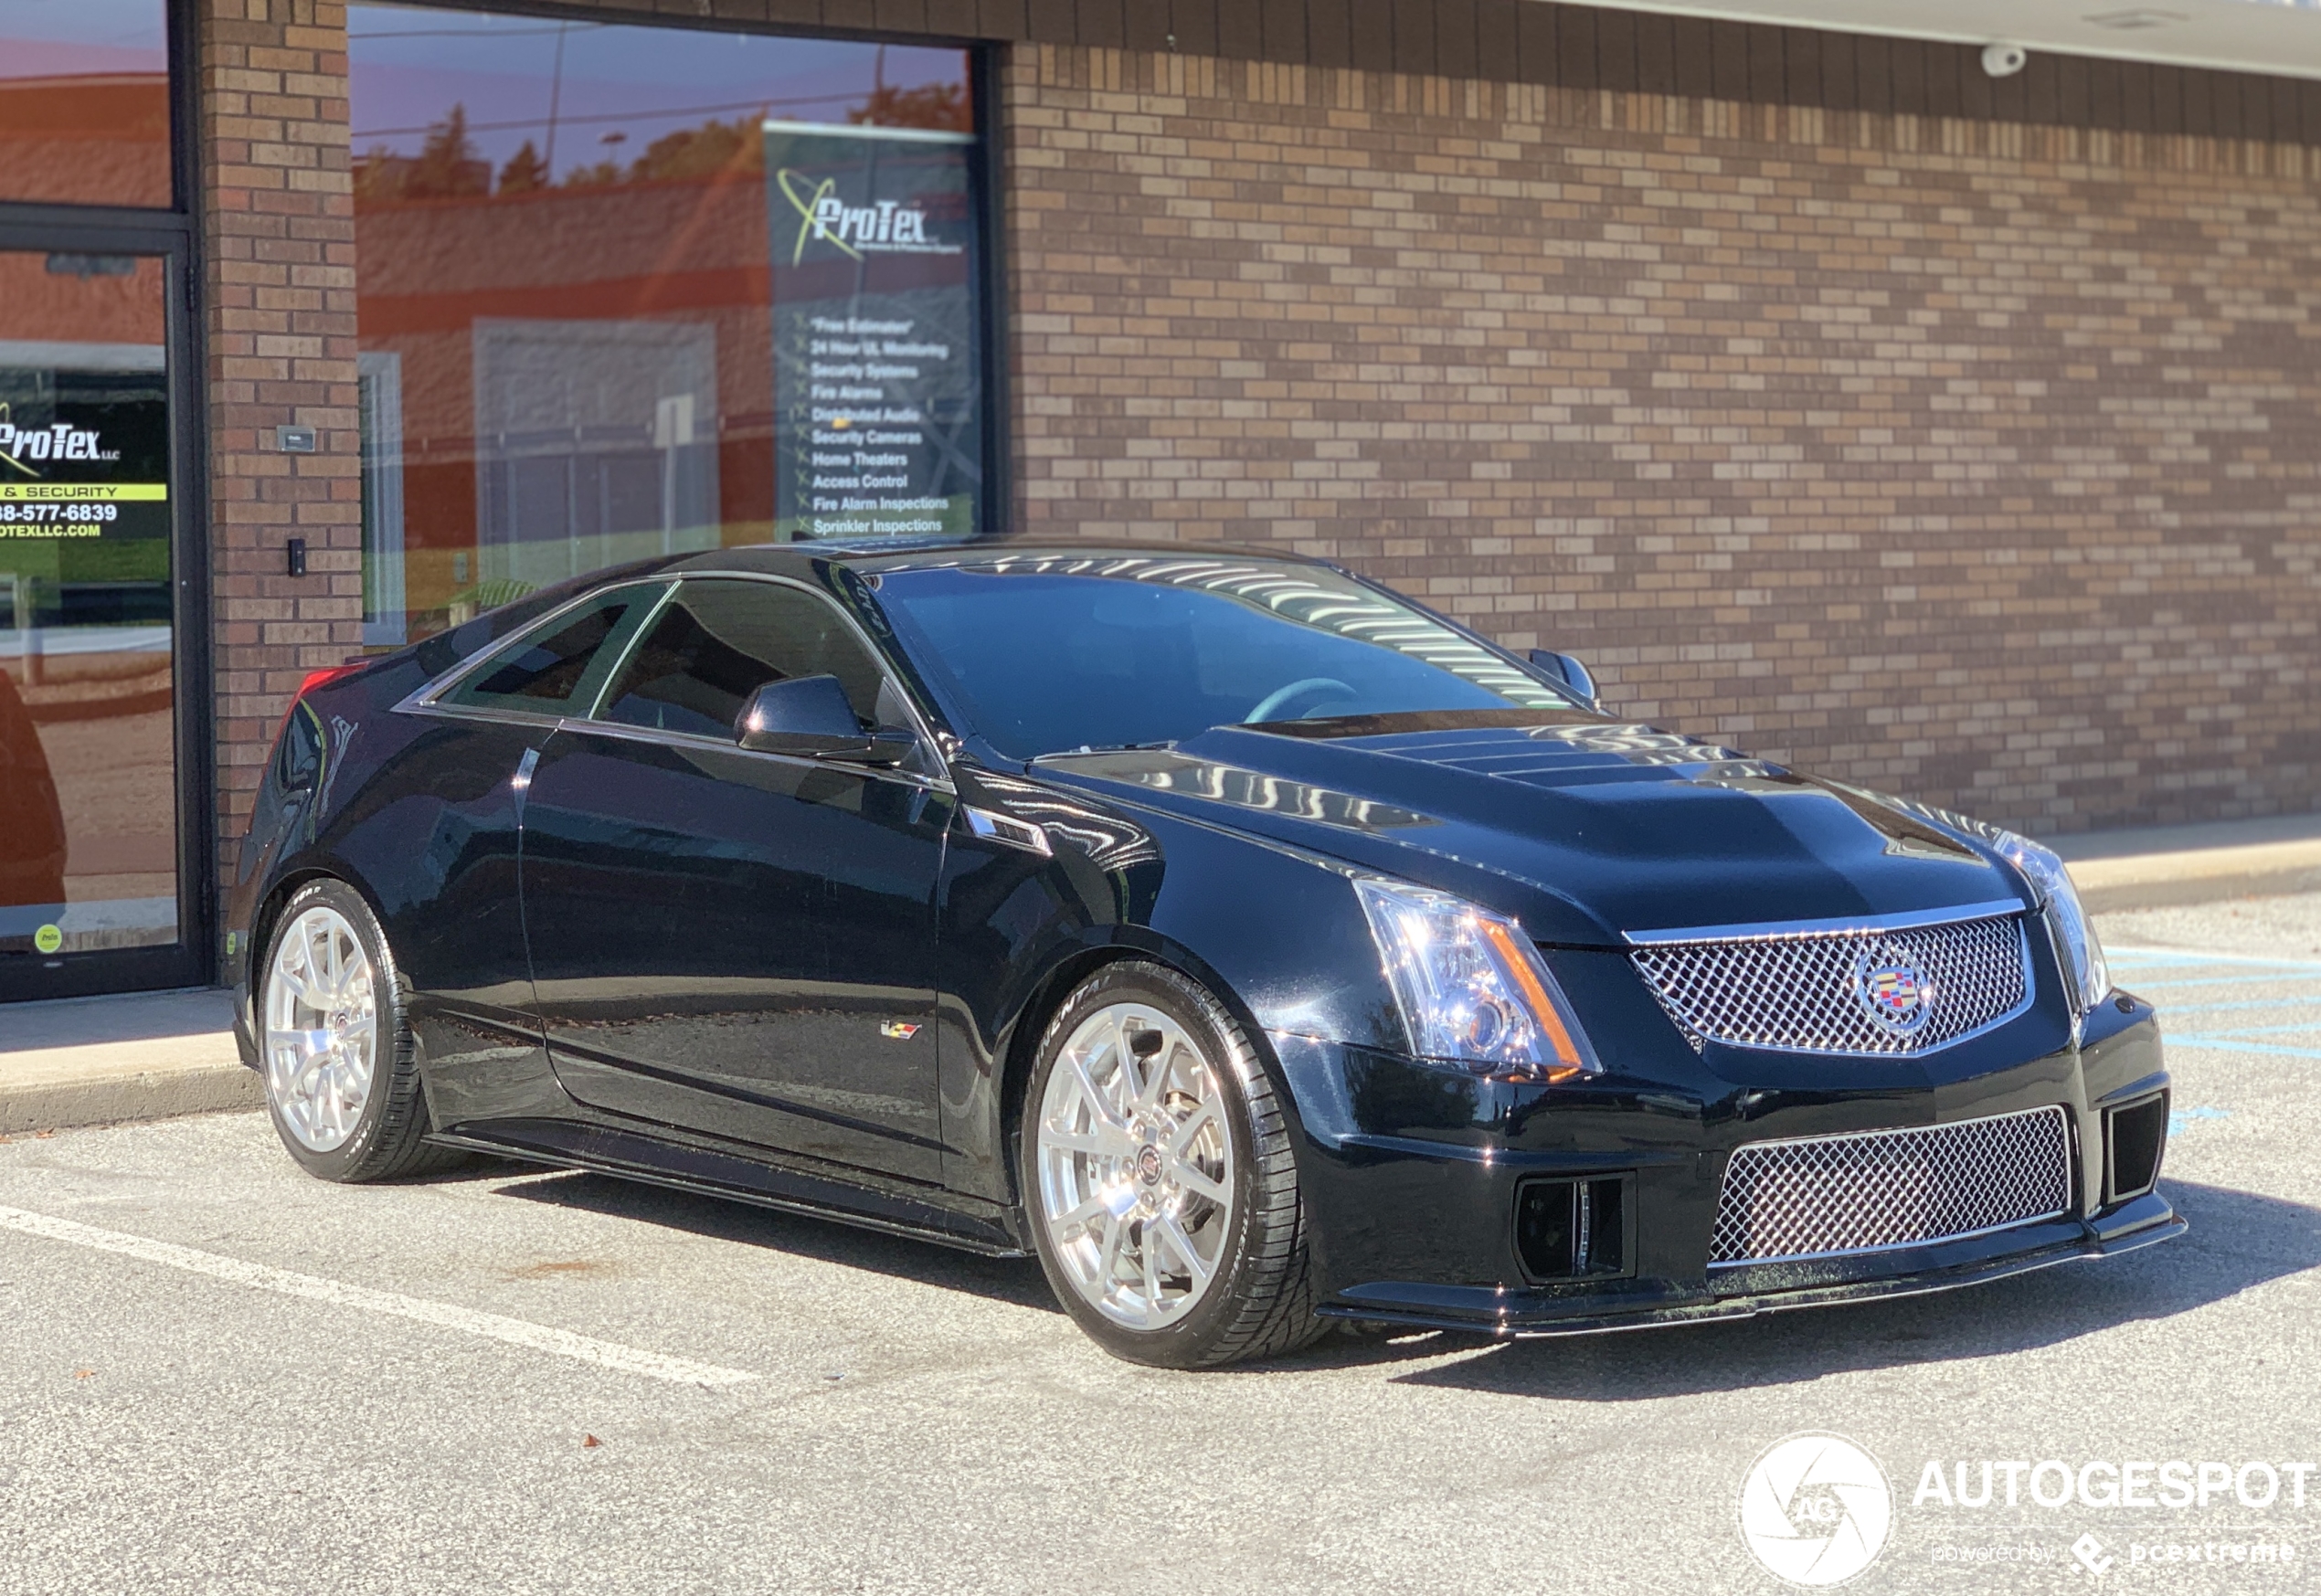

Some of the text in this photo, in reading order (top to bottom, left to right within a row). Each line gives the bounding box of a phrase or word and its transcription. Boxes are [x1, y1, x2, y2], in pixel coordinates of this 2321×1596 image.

[813, 197, 927, 243] ProTex
[811, 363, 919, 380] Security Systems
[811, 386, 883, 400] Fire Alarms
[883, 407, 920, 422] Audio
[811, 429, 922, 446] Security Cameras
[101, 450, 121, 460] LLC
[812, 452, 907, 467] Home Theaters
[812, 474, 907, 489] Access Control
[4, 487, 118, 498] & SECURITY
[0, 504, 117, 521] 8-577-6839
[813, 497, 949, 513] Fire Alarm Inspections
[813, 519, 942, 536] Sprinkler Inspections
